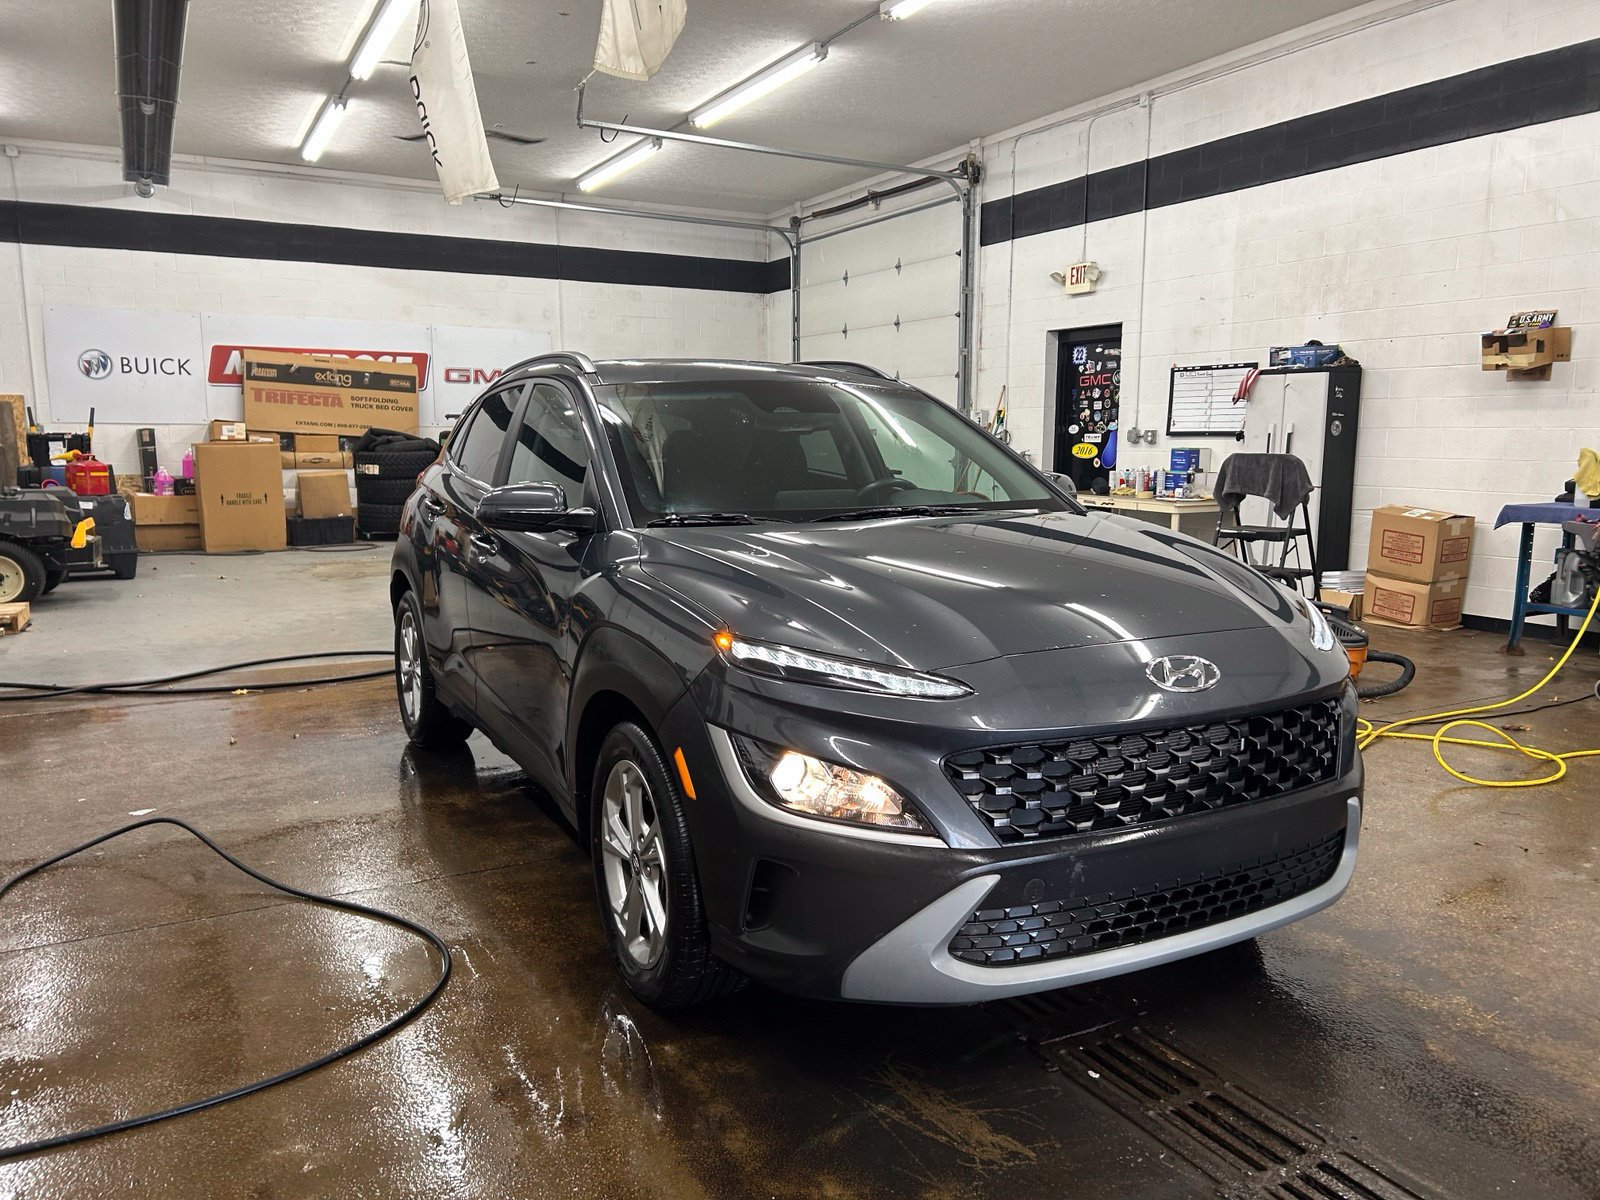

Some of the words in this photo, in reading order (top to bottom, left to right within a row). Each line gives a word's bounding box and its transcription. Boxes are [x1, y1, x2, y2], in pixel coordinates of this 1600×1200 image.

[1070, 265, 1088, 285] EXIT
[120, 356, 192, 376] BUICK
[314, 370, 352, 387] extang
[1079, 373, 1112, 387] GMC
[250, 387, 345, 409] TRIFECTA
[1075, 446, 1093, 456] 2016
